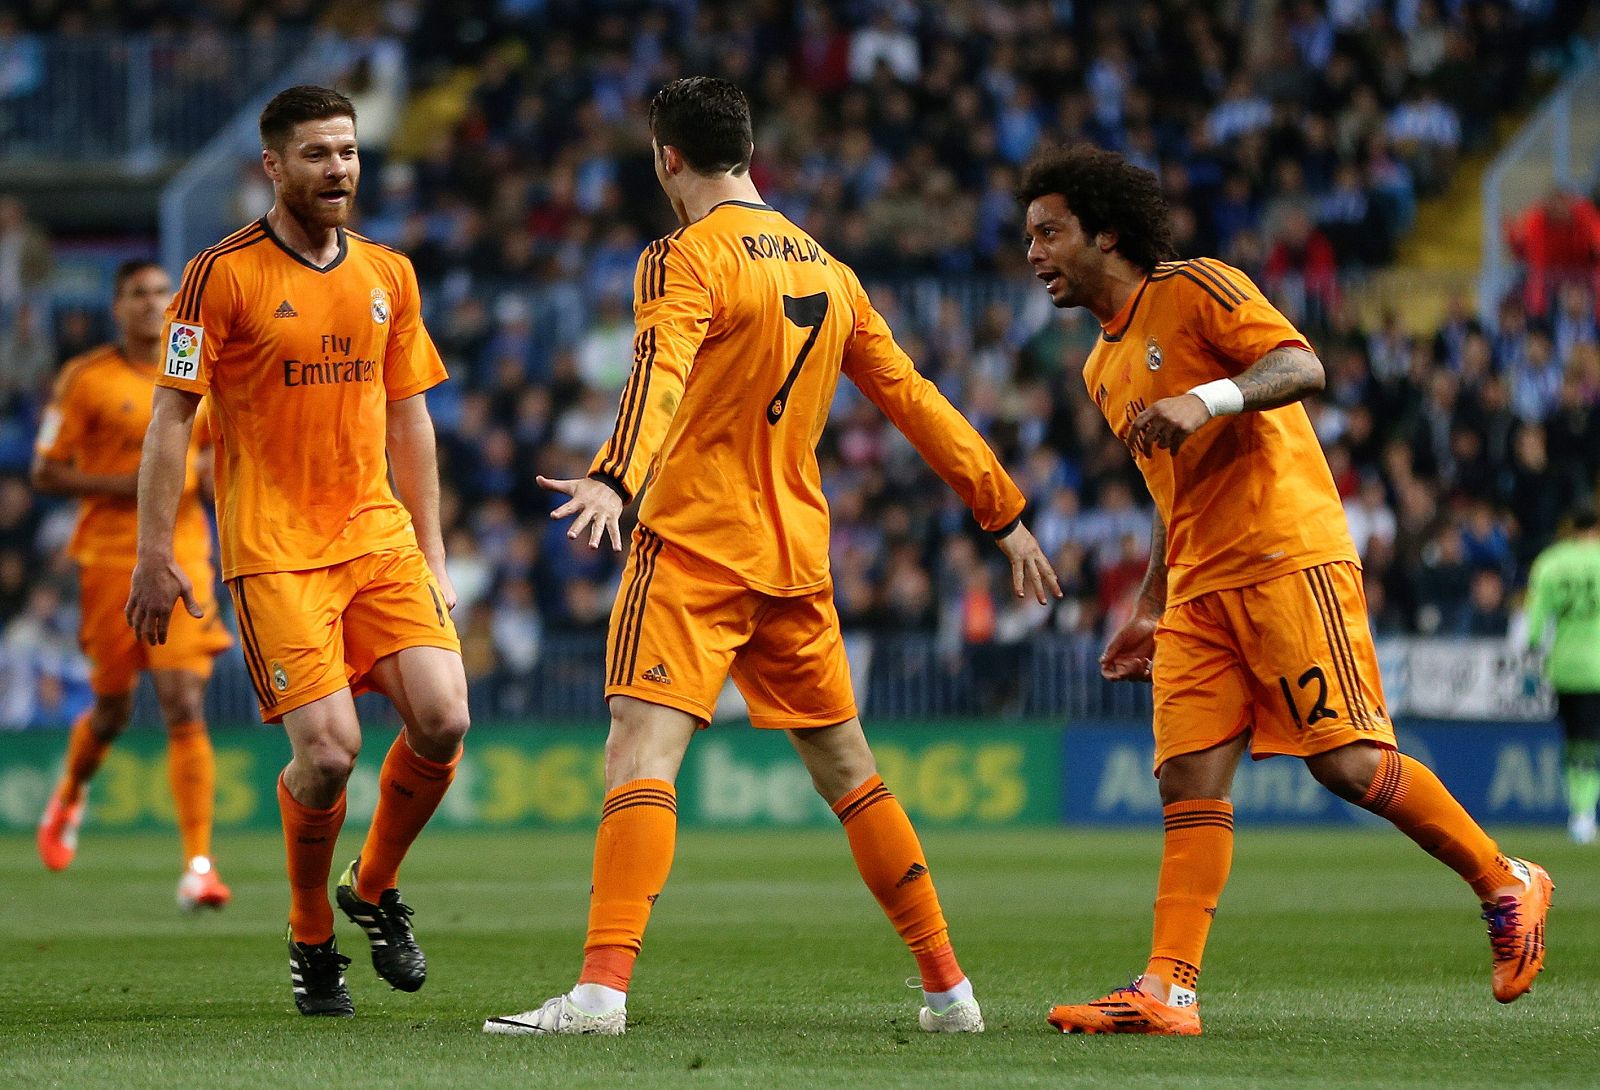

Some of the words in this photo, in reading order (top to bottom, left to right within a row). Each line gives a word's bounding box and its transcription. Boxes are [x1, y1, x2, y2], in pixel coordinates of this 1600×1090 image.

[321, 334, 352, 356] Fly
[766, 291, 829, 426] 7
[168, 358, 194, 377] LFP
[283, 356, 376, 387] Emirates
[1280, 666, 1339, 729] 12
